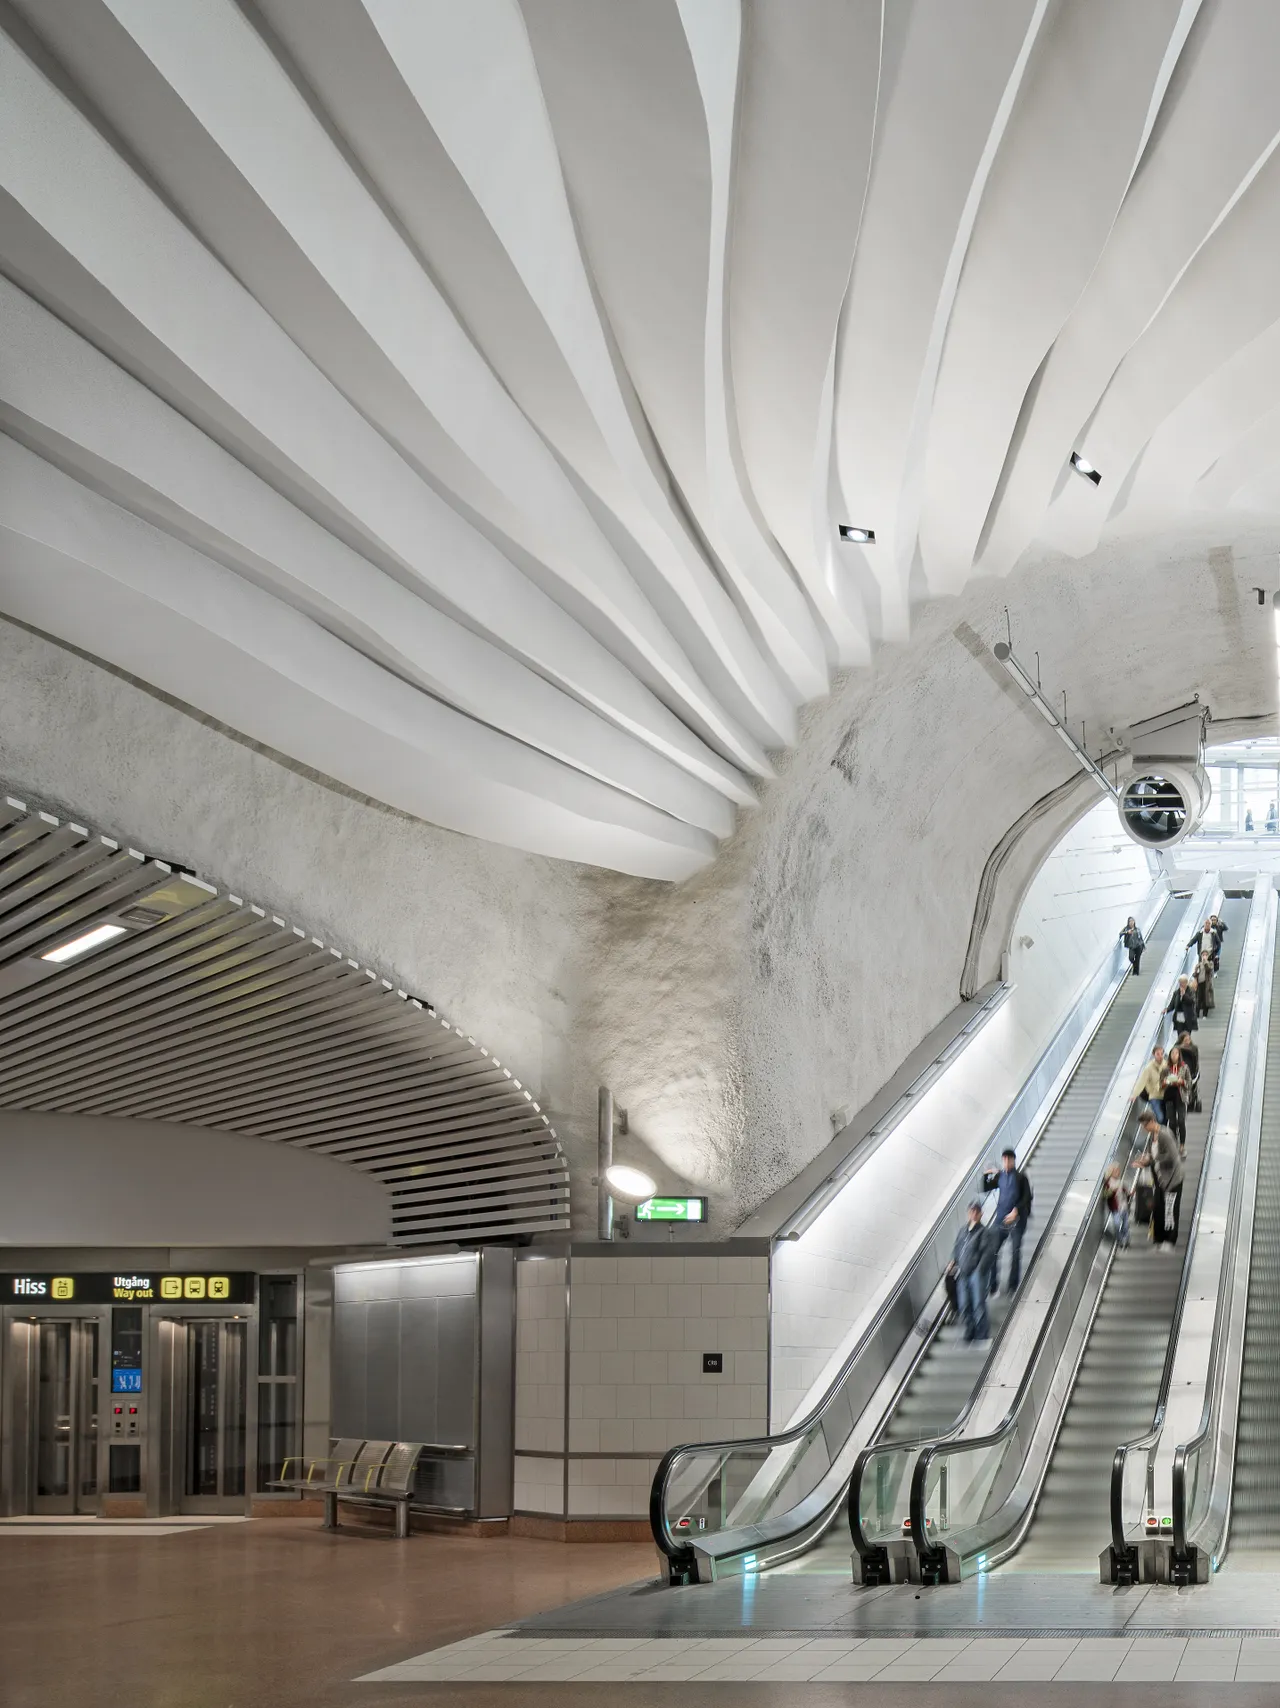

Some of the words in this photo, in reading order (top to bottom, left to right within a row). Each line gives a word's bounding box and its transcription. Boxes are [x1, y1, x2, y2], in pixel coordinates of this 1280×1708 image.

[14, 1278, 46, 1294] Hiss
[114, 1276, 150, 1289] Utgång
[114, 1288, 135, 1300] Way
[136, 1289, 153, 1298] out
